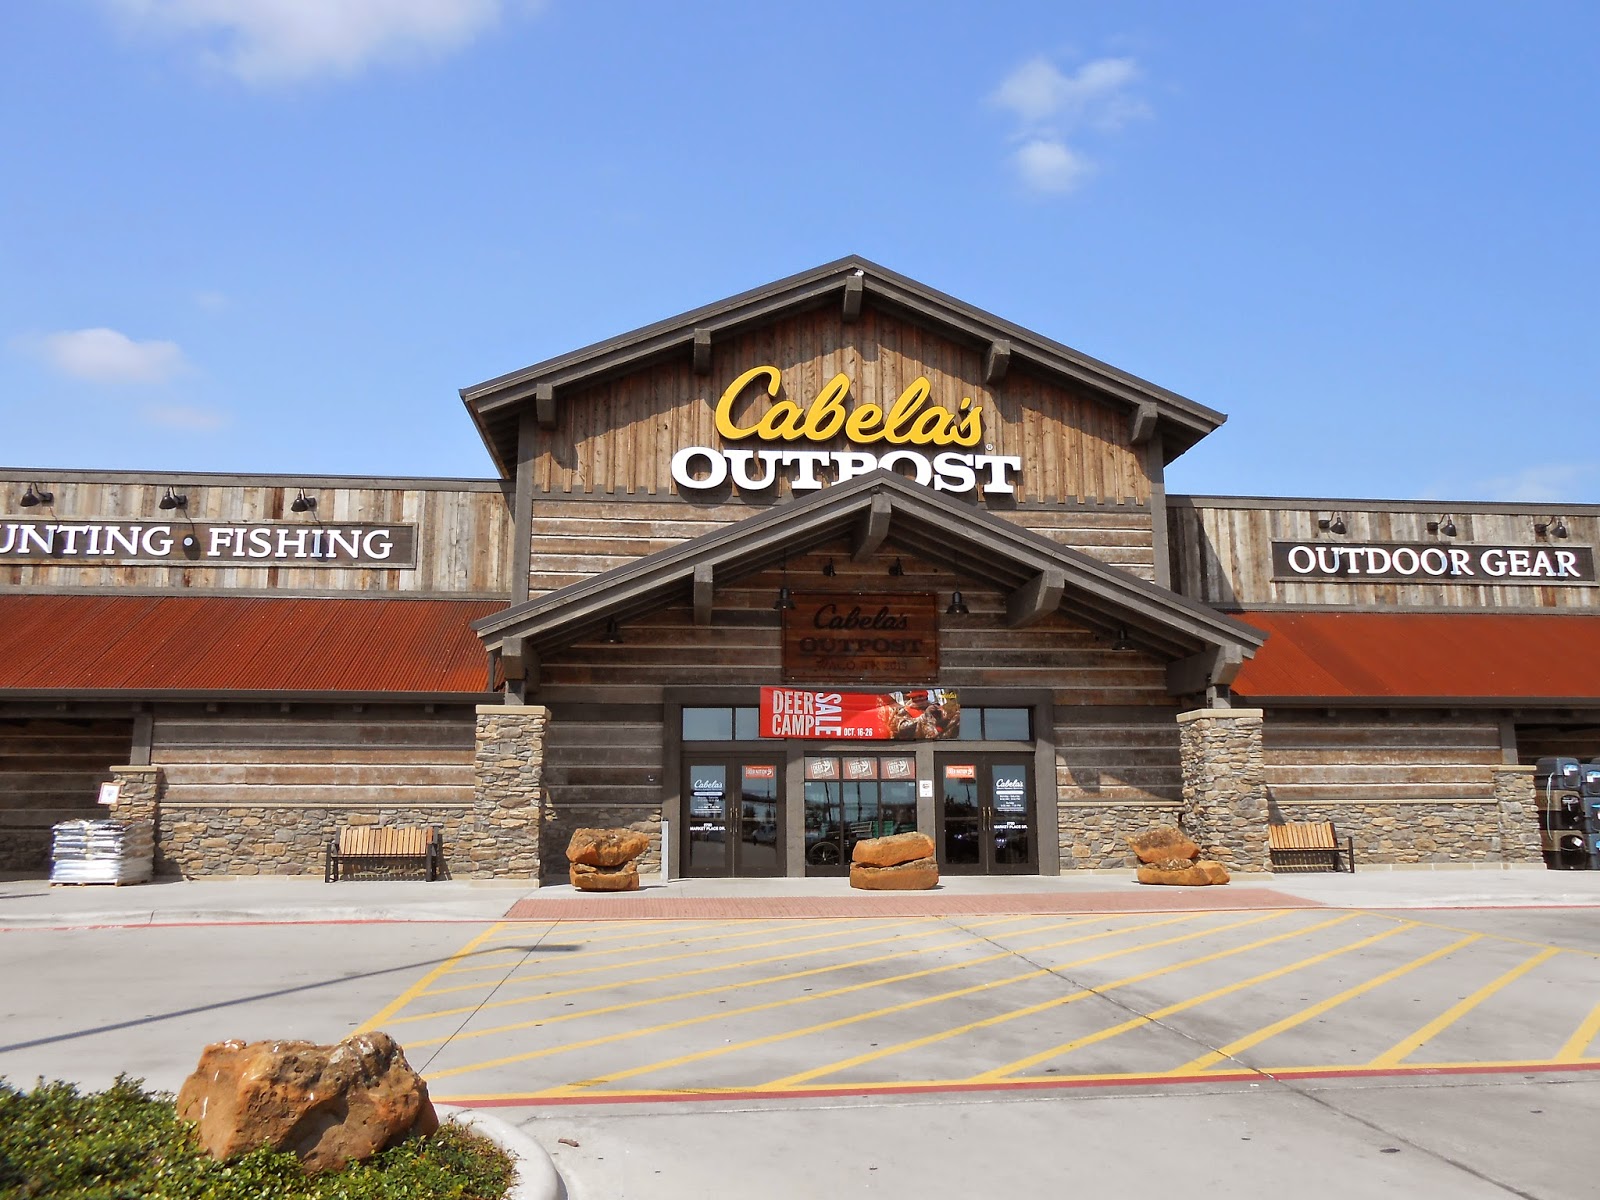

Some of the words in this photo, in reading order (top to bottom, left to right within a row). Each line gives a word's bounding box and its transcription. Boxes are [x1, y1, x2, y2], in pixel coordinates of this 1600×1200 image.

[715, 365, 984, 447] Cabela's
[671, 446, 1022, 493] OUTPOST
[207, 527, 394, 560] FISHING
[1288, 545, 1475, 577] OUTDOOR
[1480, 549, 1581, 578] GEAR
[813, 603, 908, 631] Cabela's
[799, 636, 923, 653] OUTPOST
[773, 690, 814, 714] DEER
[815, 693, 842, 736] SALE
[772, 714, 815, 735] CAMP
[843, 728, 856, 737] OCT.
[857, 727, 873, 737] 16-26
